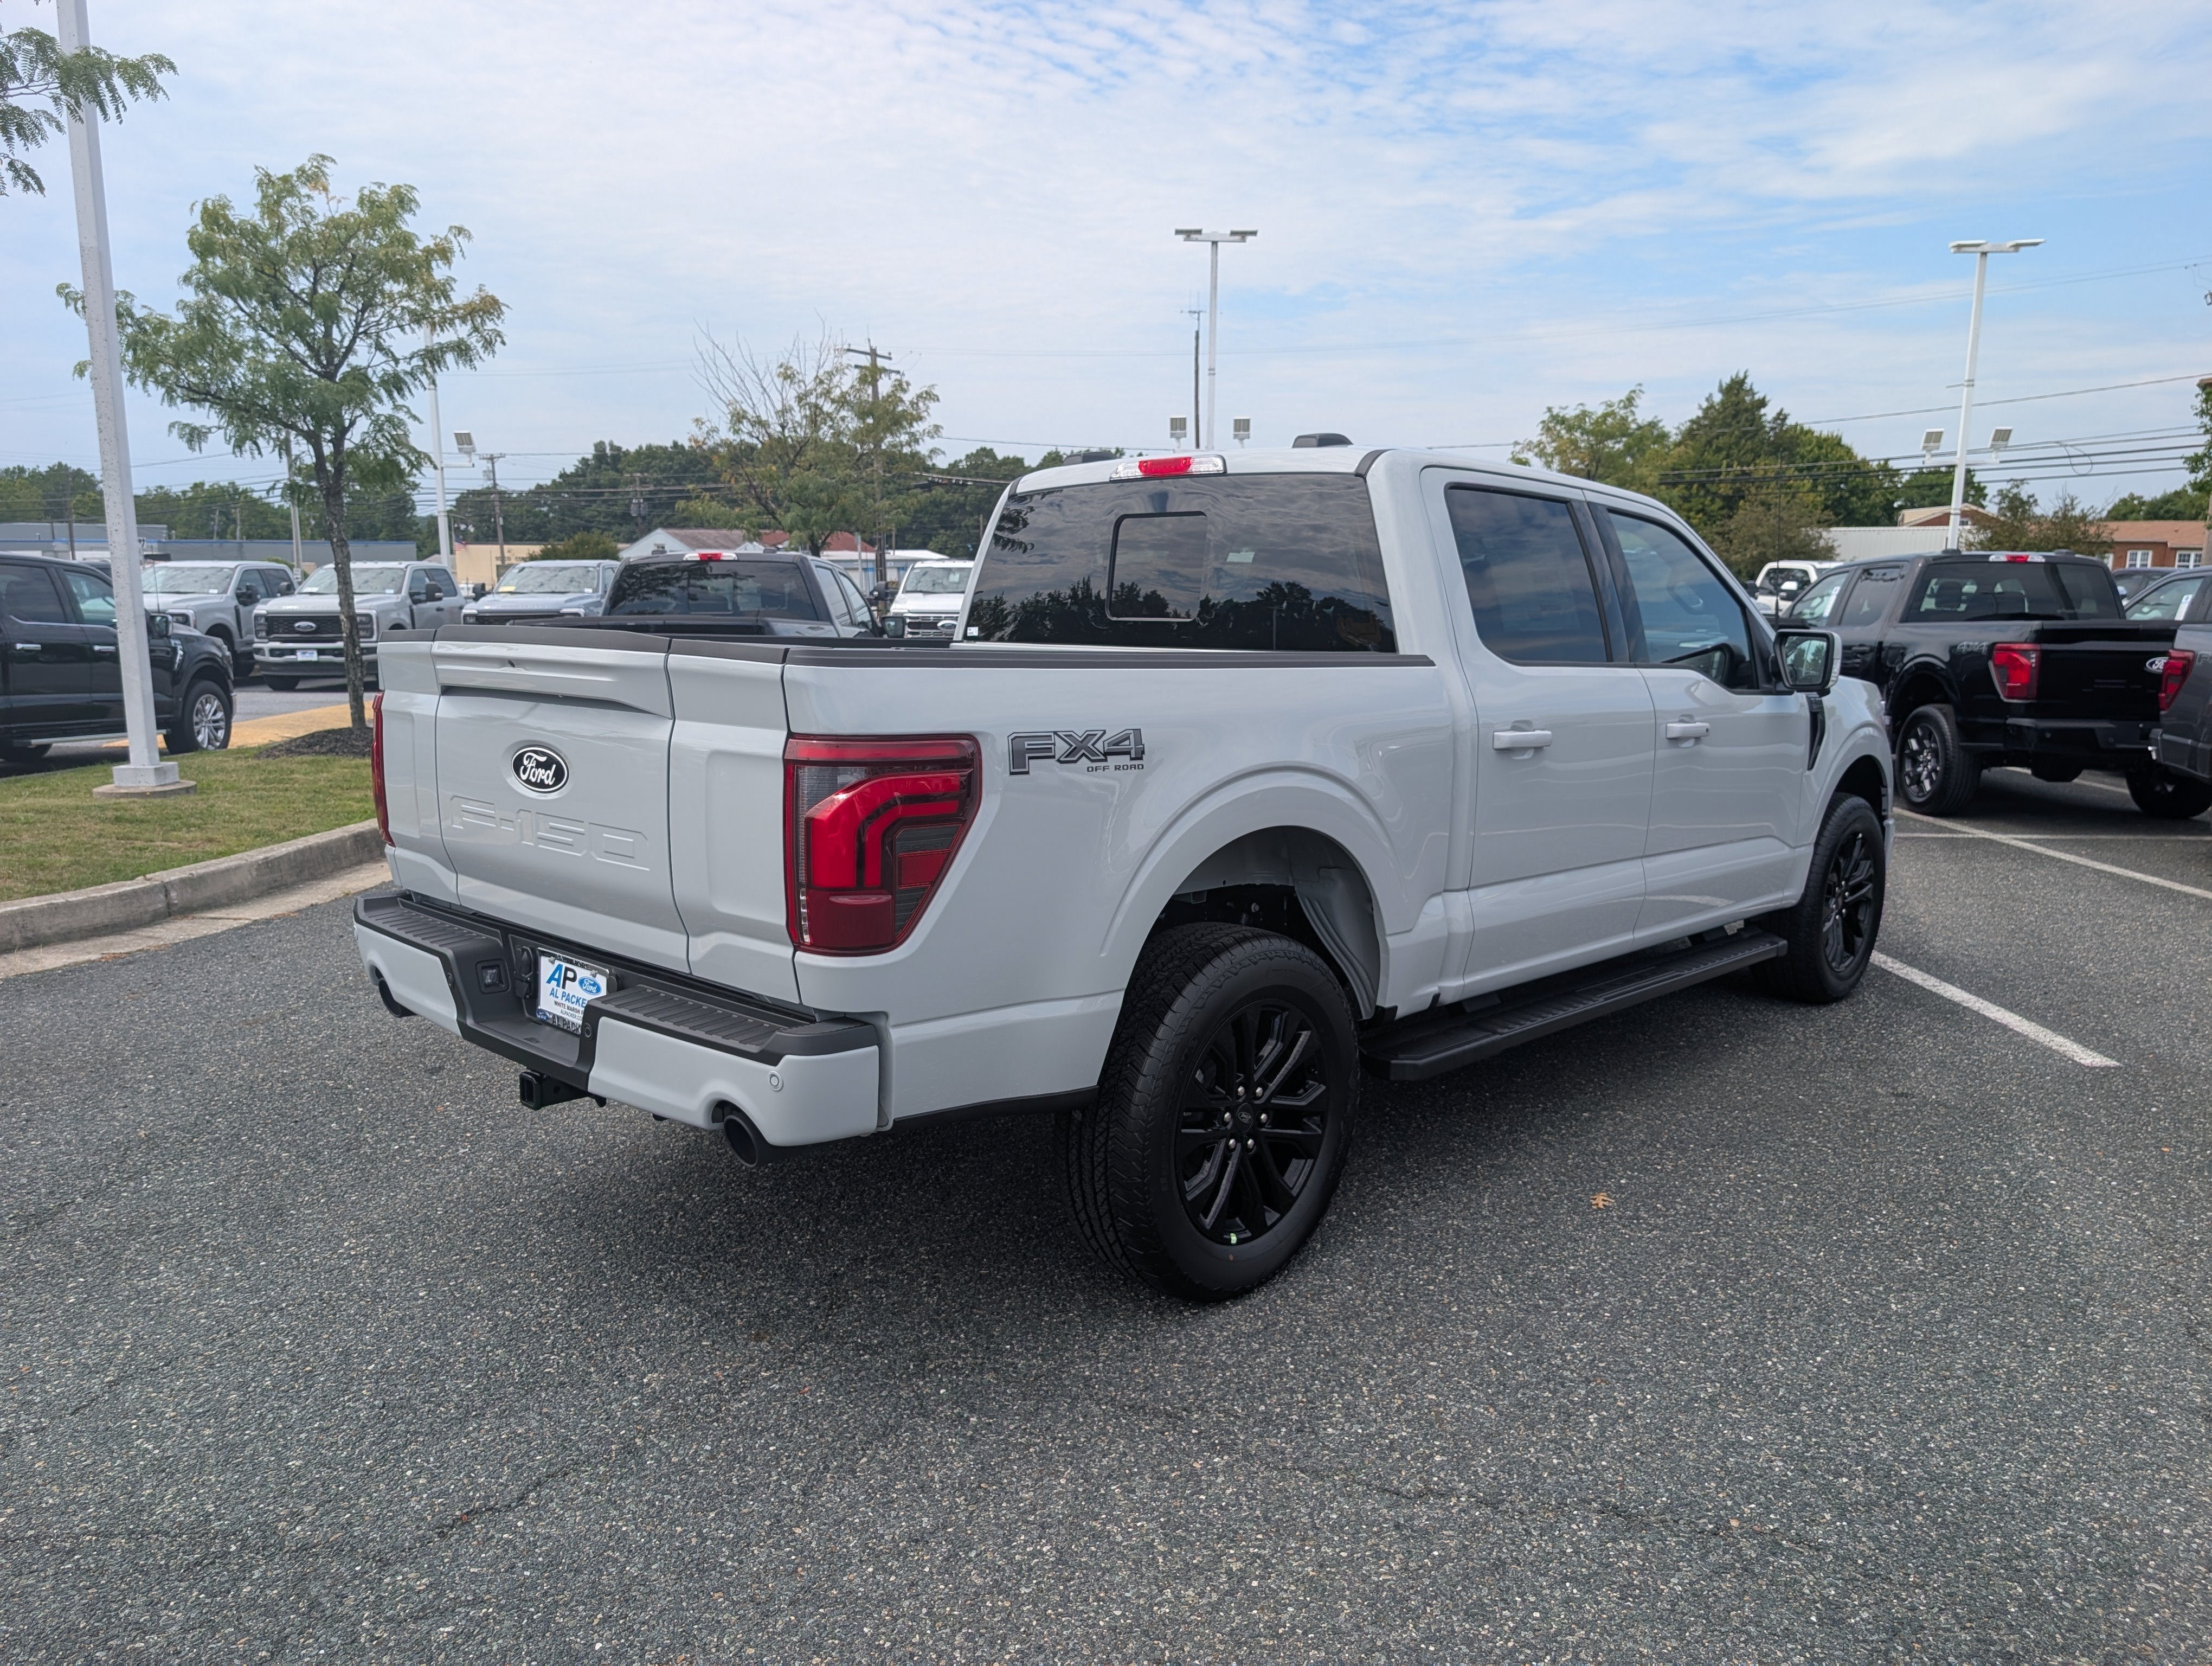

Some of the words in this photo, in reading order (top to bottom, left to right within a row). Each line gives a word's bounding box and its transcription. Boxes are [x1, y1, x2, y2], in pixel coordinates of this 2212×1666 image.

[1007, 728, 1145, 776] FX4
[520, 752, 556, 785] Ford
[1114, 764, 1144, 772] ROAD
[450, 795, 650, 871] F-150
[546, 963, 577, 990] AP
[582, 978, 597, 993] Ford
[549, 988, 559, 998] AL
[561, 991, 587, 1008] PACKE
[552, 1014, 561, 1027] AL
[563, 1018, 581, 1035] PACK
[560, 1009, 583, 1021] ALPACKER.CO
